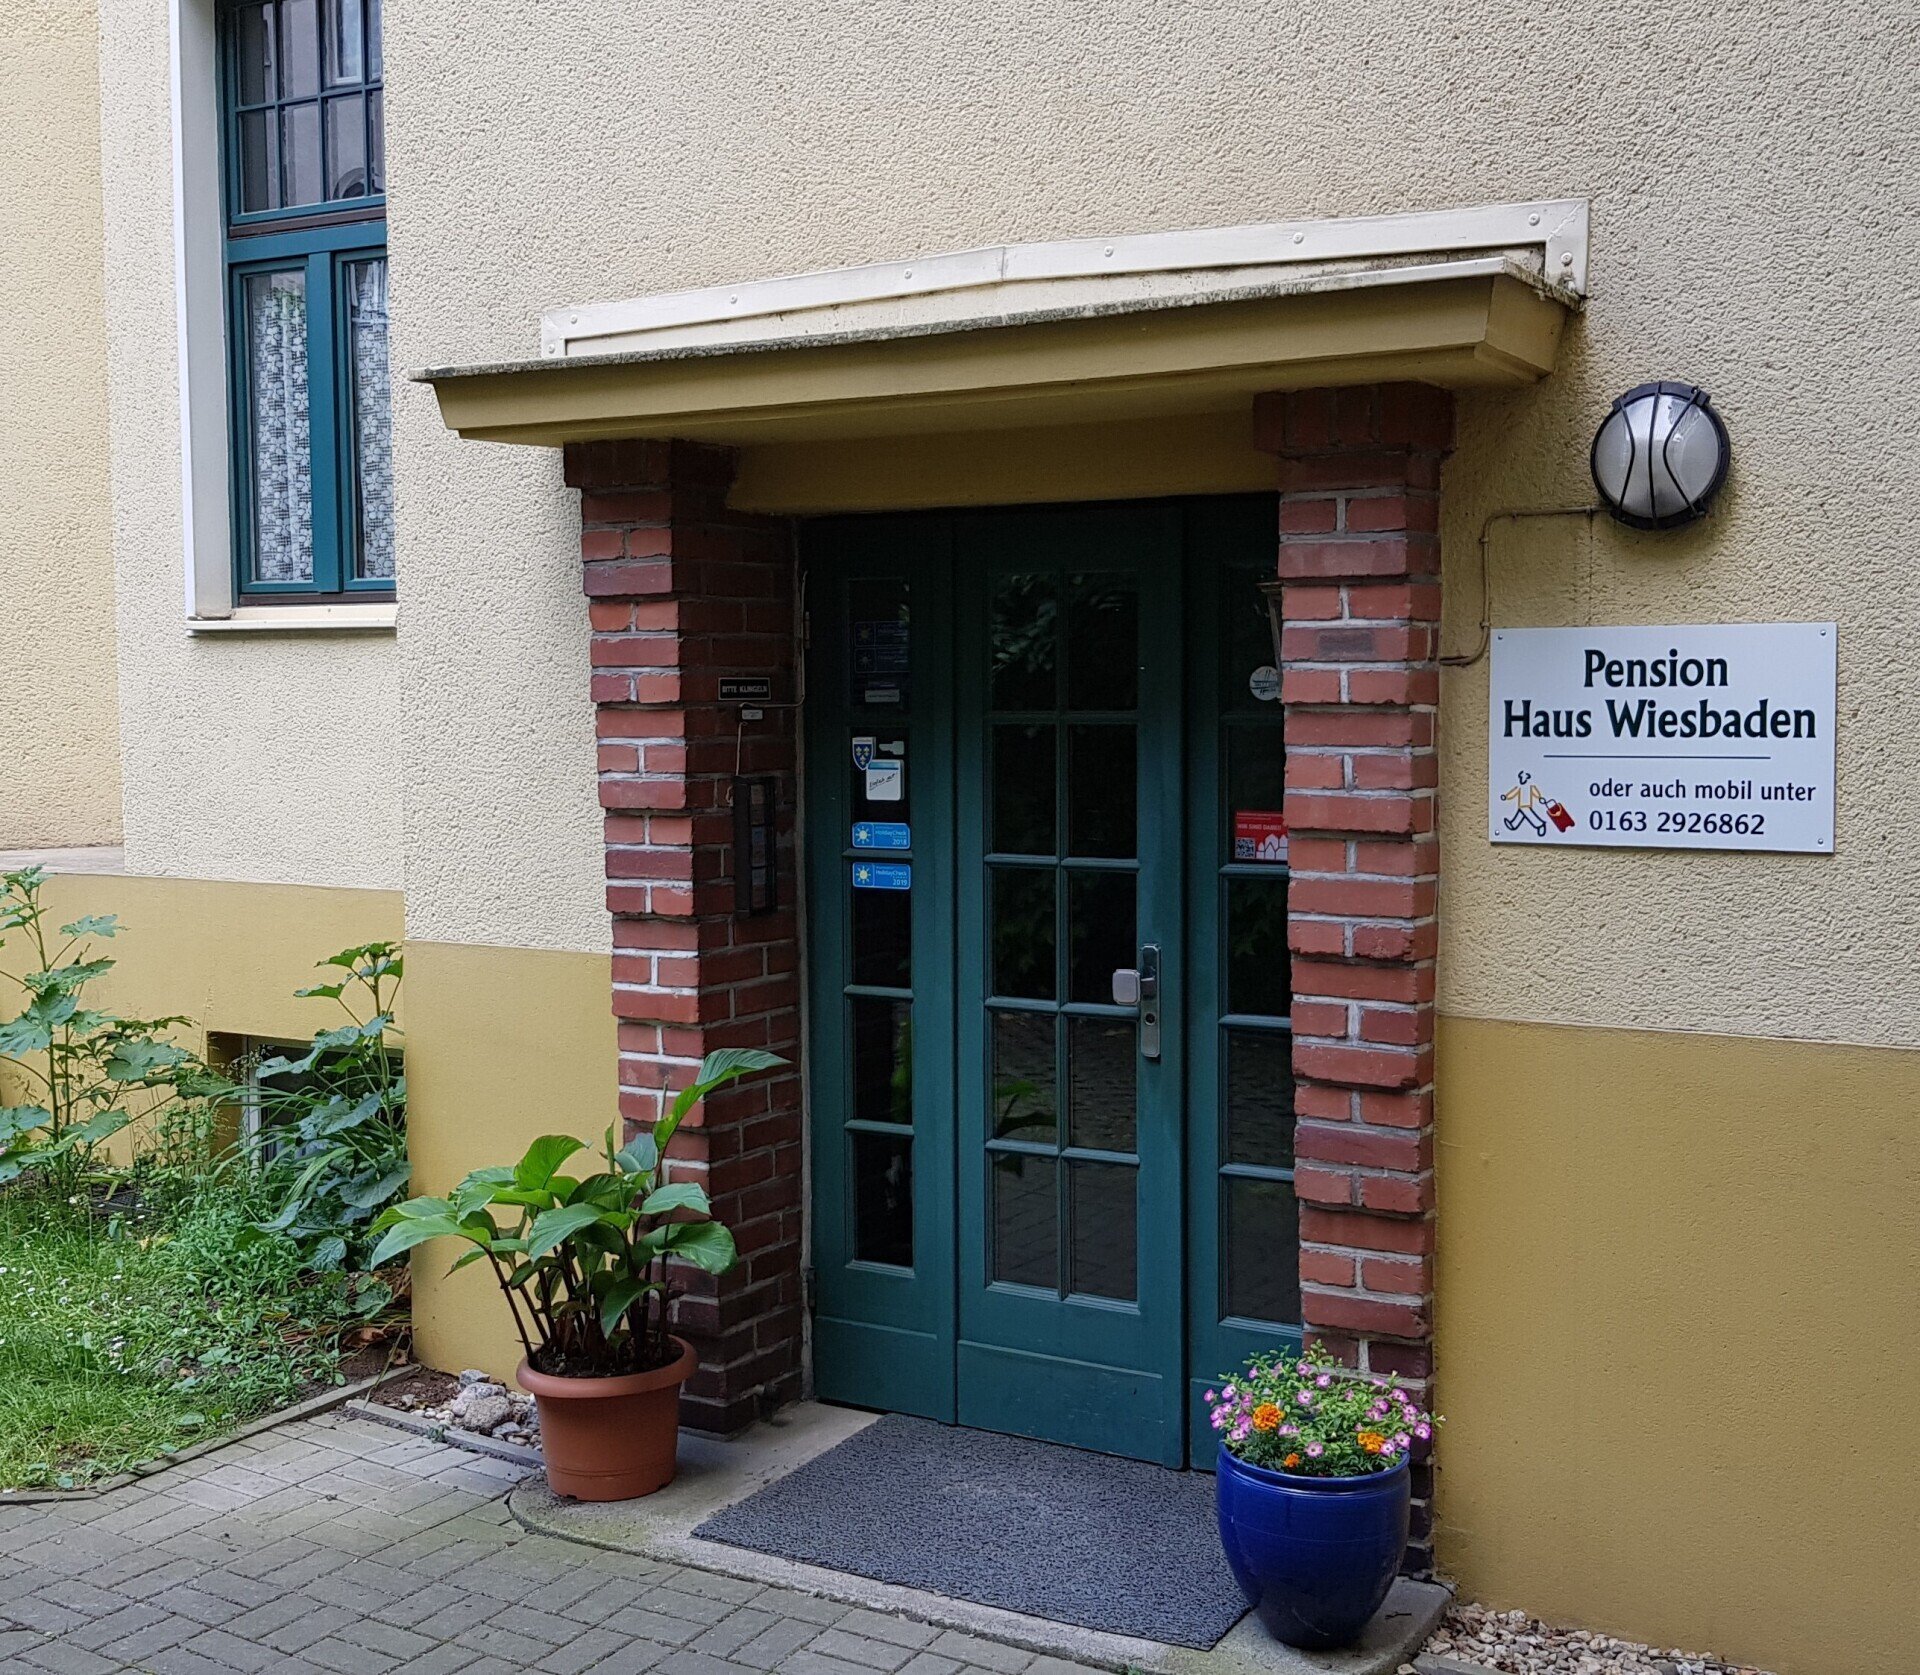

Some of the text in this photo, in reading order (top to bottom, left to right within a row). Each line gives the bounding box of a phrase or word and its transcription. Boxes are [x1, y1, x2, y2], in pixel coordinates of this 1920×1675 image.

[1583, 648, 1729, 688] Pension
[1502, 697, 1817, 739] Haus Wiesbaden
[1589, 778, 1817, 802] oder auch mobil unter
[1589, 810, 1765, 835] 0163 2926862
